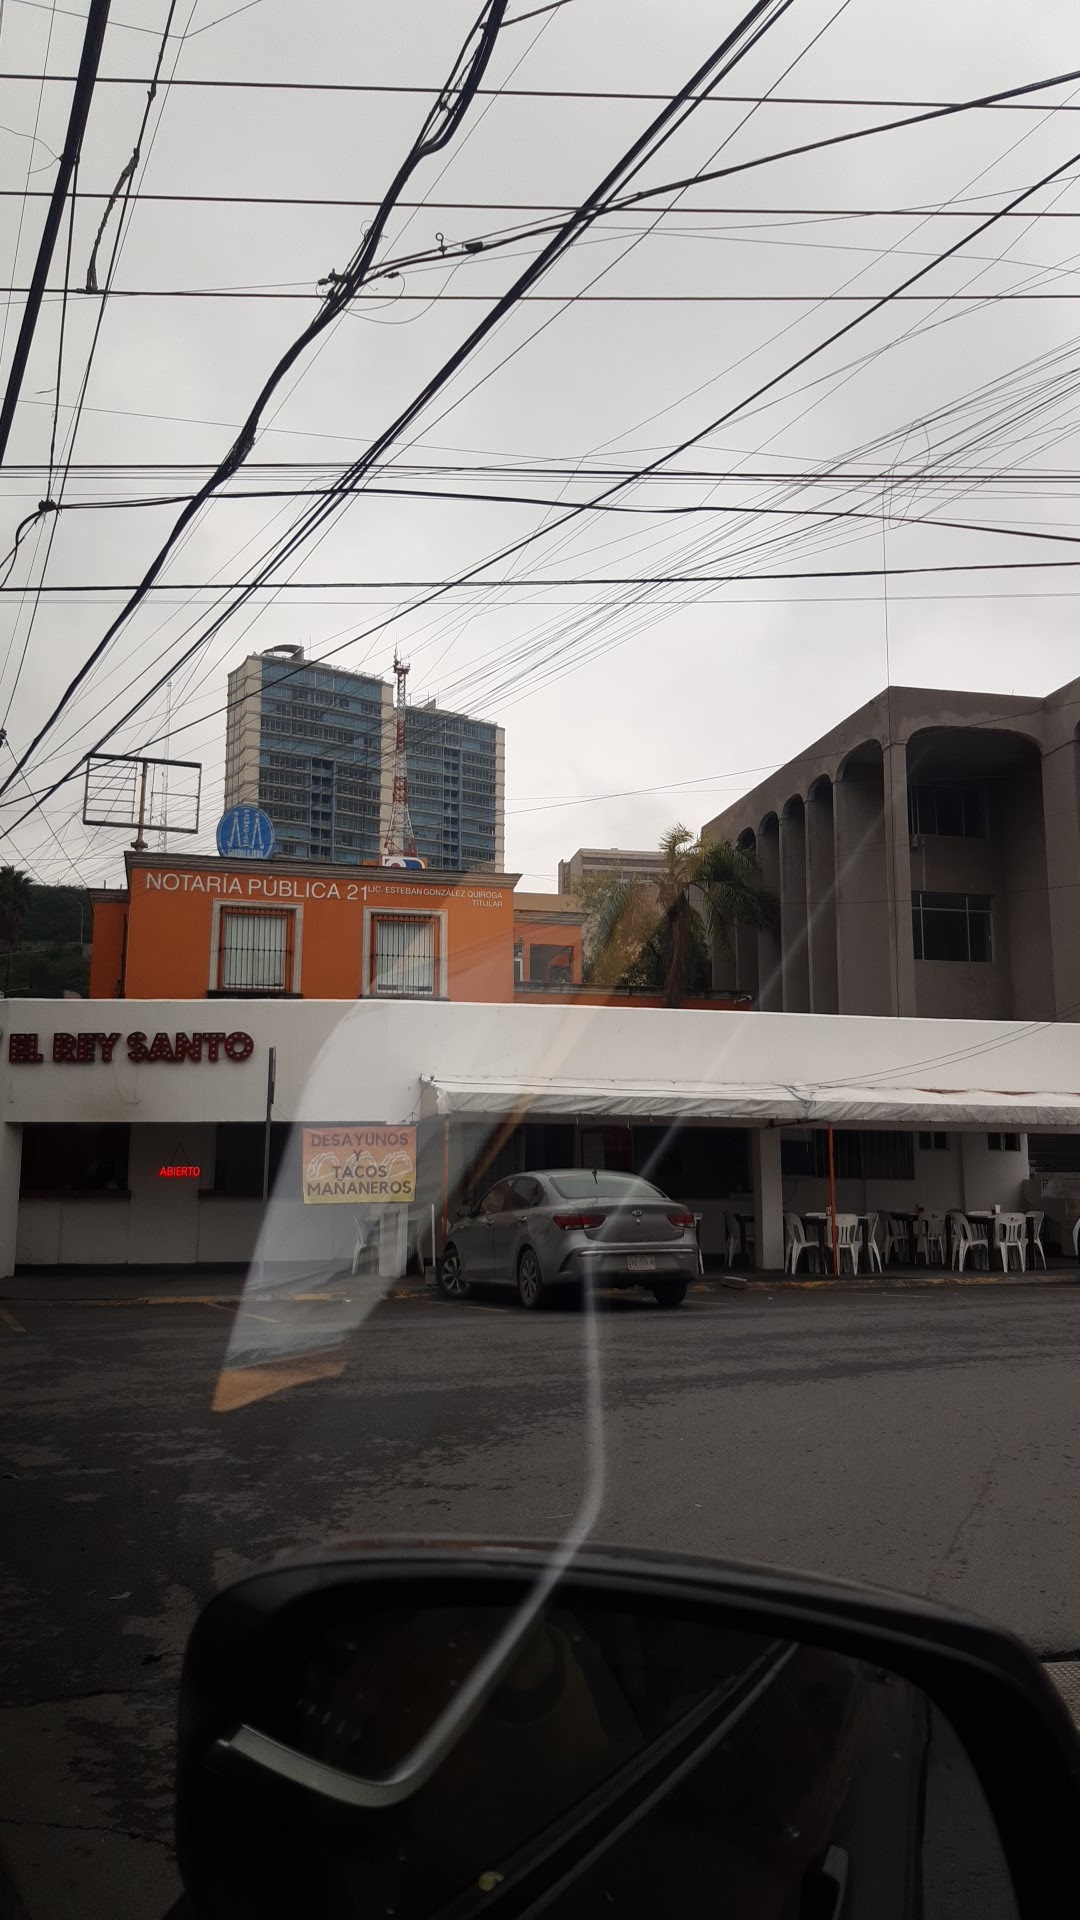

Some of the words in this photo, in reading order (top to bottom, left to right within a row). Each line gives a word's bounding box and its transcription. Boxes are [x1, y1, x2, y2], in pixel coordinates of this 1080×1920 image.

[146, 872, 242, 895] NOTARÍA
[248, 876, 341, 900] PÚBLICA
[346, 884, 368, 901] 21
[368, 886, 384, 894] LIC.
[385, 886, 423, 896] ESTEBAN
[423, 887, 466, 898] GONZÁLEZ
[467, 890, 503, 899] QUIROGA
[472, 899, 503, 908] TITULAR
[8, 1033, 44, 1063] EL
[53, 1032, 122, 1063] REY
[127, 1031, 255, 1063] SANTO
[310, 1132, 409, 1148] DESAYUNOS
[352, 1149, 363, 1161] Y
[158, 1165, 201, 1178] ABIERTO
[332, 1165, 388, 1179] TACOS
[307, 1177, 412, 1196] MAÑANEROS
